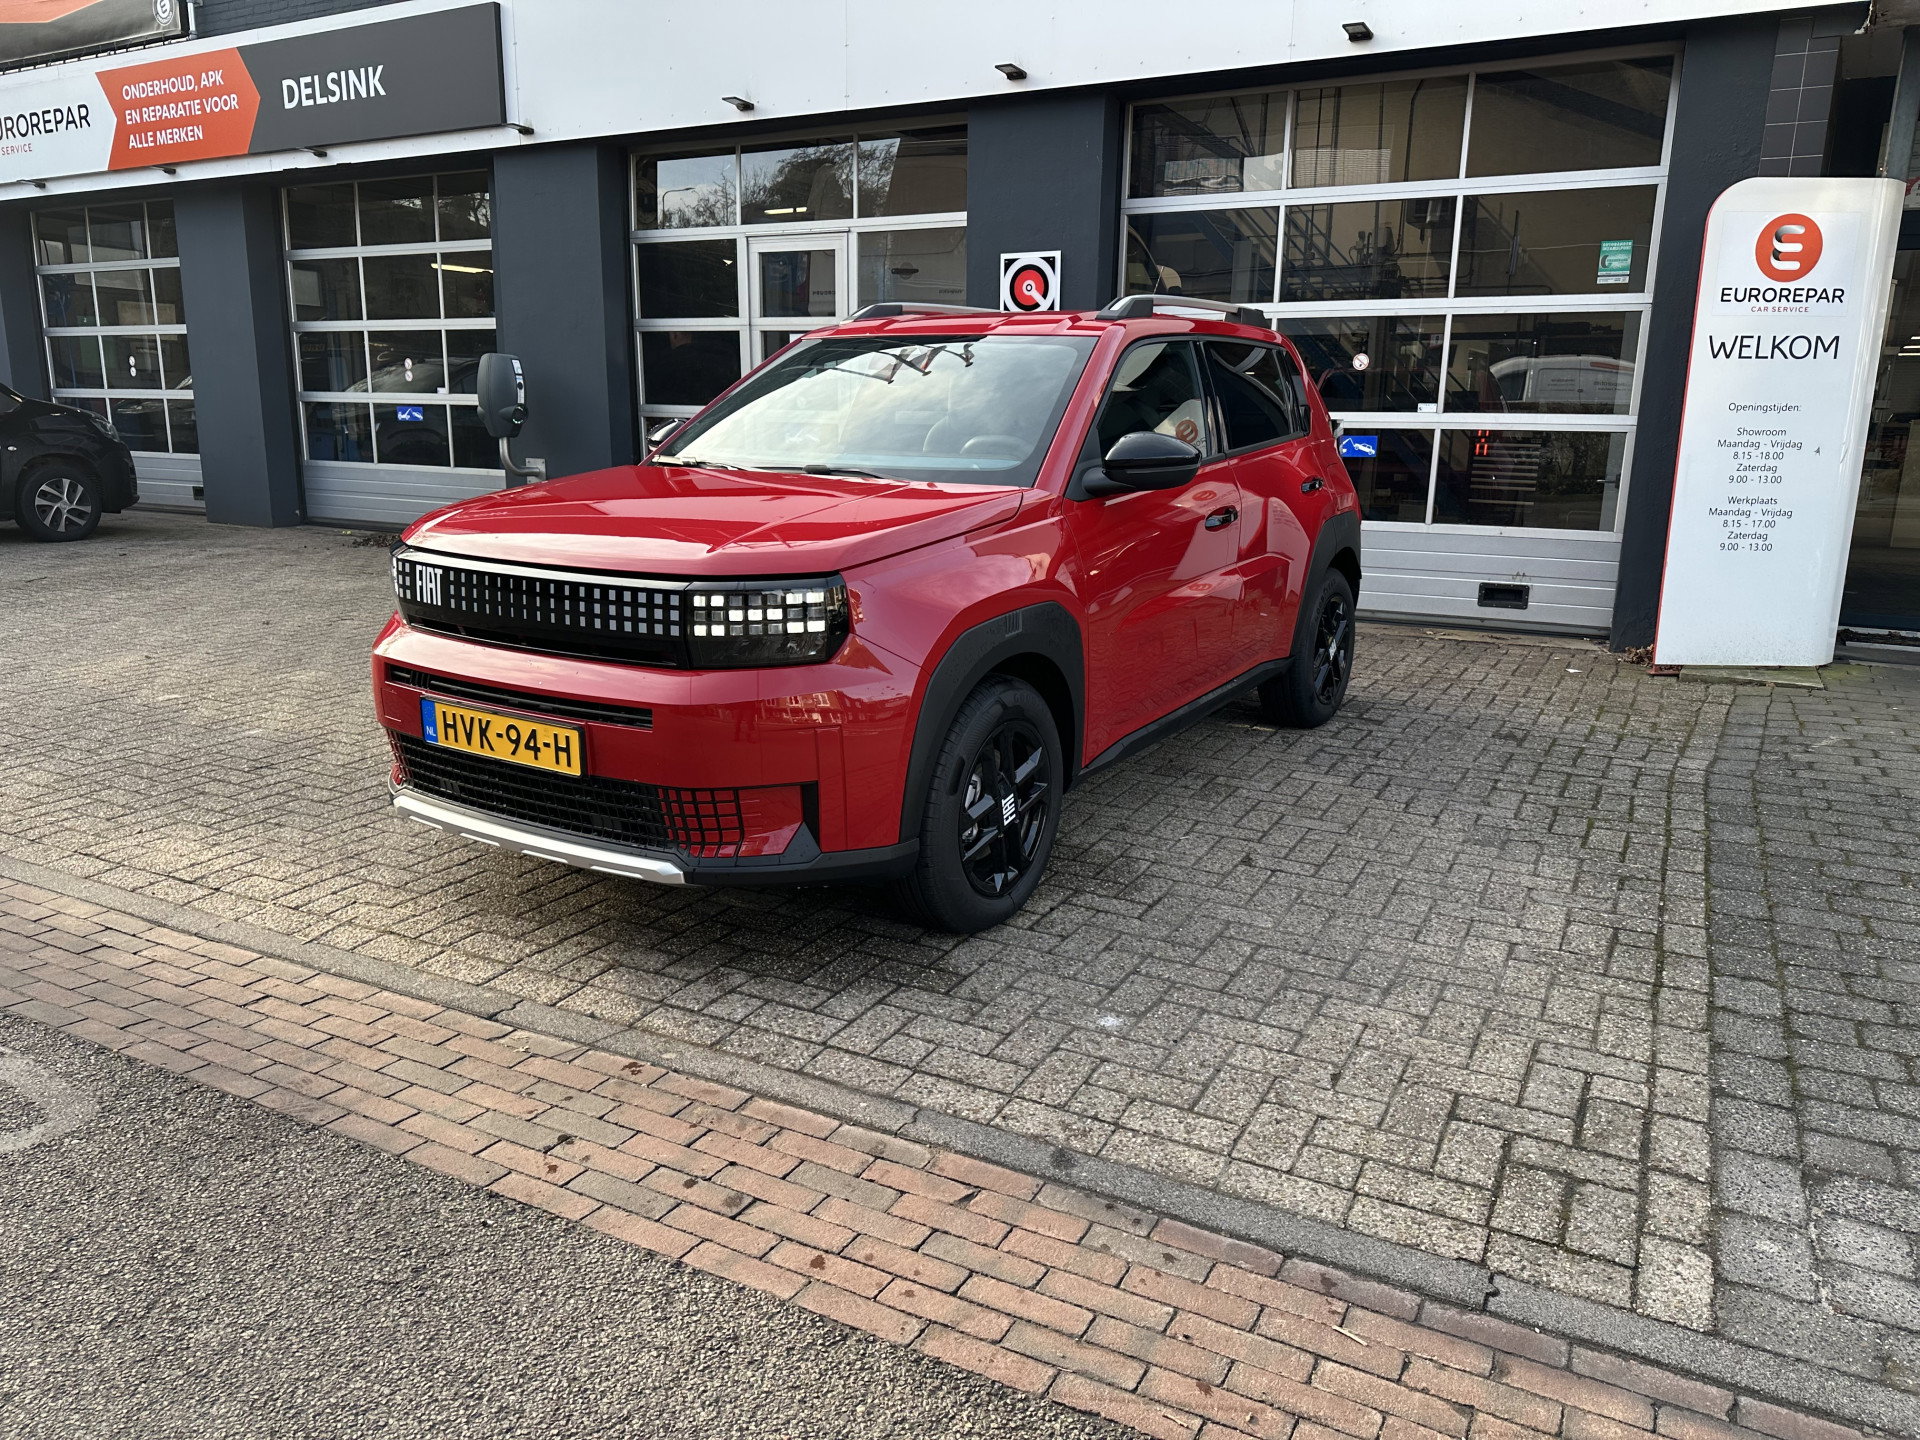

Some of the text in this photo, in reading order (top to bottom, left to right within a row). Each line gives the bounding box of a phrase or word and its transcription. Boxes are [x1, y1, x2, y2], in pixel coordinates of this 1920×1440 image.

[122, 69, 224, 100] ONDERHOUD, APK
[282, 64, 387, 110] DELSINK
[125, 94, 239, 125] EN REPARATIE VOOR
[0, 103, 91, 140] ROREPAR
[128, 124, 203, 150] ALLE MERKEN
[1, 142, 33, 156] SERVICE
[1720, 287, 1845, 304] EUROREPAR
[1709, 335, 1840, 360] WELKOM
[1728, 402, 1802, 414] Openingstijden:
[1736, 427, 1787, 436] Showroom
[1717, 439, 1760, 450] Maandag
[1770, 440, 1803, 450] Vrijdag
[1733, 451, 1752, 460] 8.15
[1736, 463, 1778, 474] Zaterdag
[1728, 475, 1748, 484] 9.00
[1758, 475, 1783, 484] 13.00
[1727, 496, 1778, 506] Werkplaats
[1708, 508, 1751, 518] Maandag
[1761, 508, 1793, 519] Vrijdag
[1722, 520, 1741, 528] 8.15
[1752, 520, 1776, 528] 17.00
[1727, 531, 1768, 542] Zaterdag
[1719, 543, 1739, 551] 9.00
[1749, 543, 1773, 551] 13.00
[415, 564, 443, 606] FIAT
[426, 726, 436, 737] NL
[442, 710, 572, 768] HVK-94-H
[1001, 793, 1016, 826] FIAT
